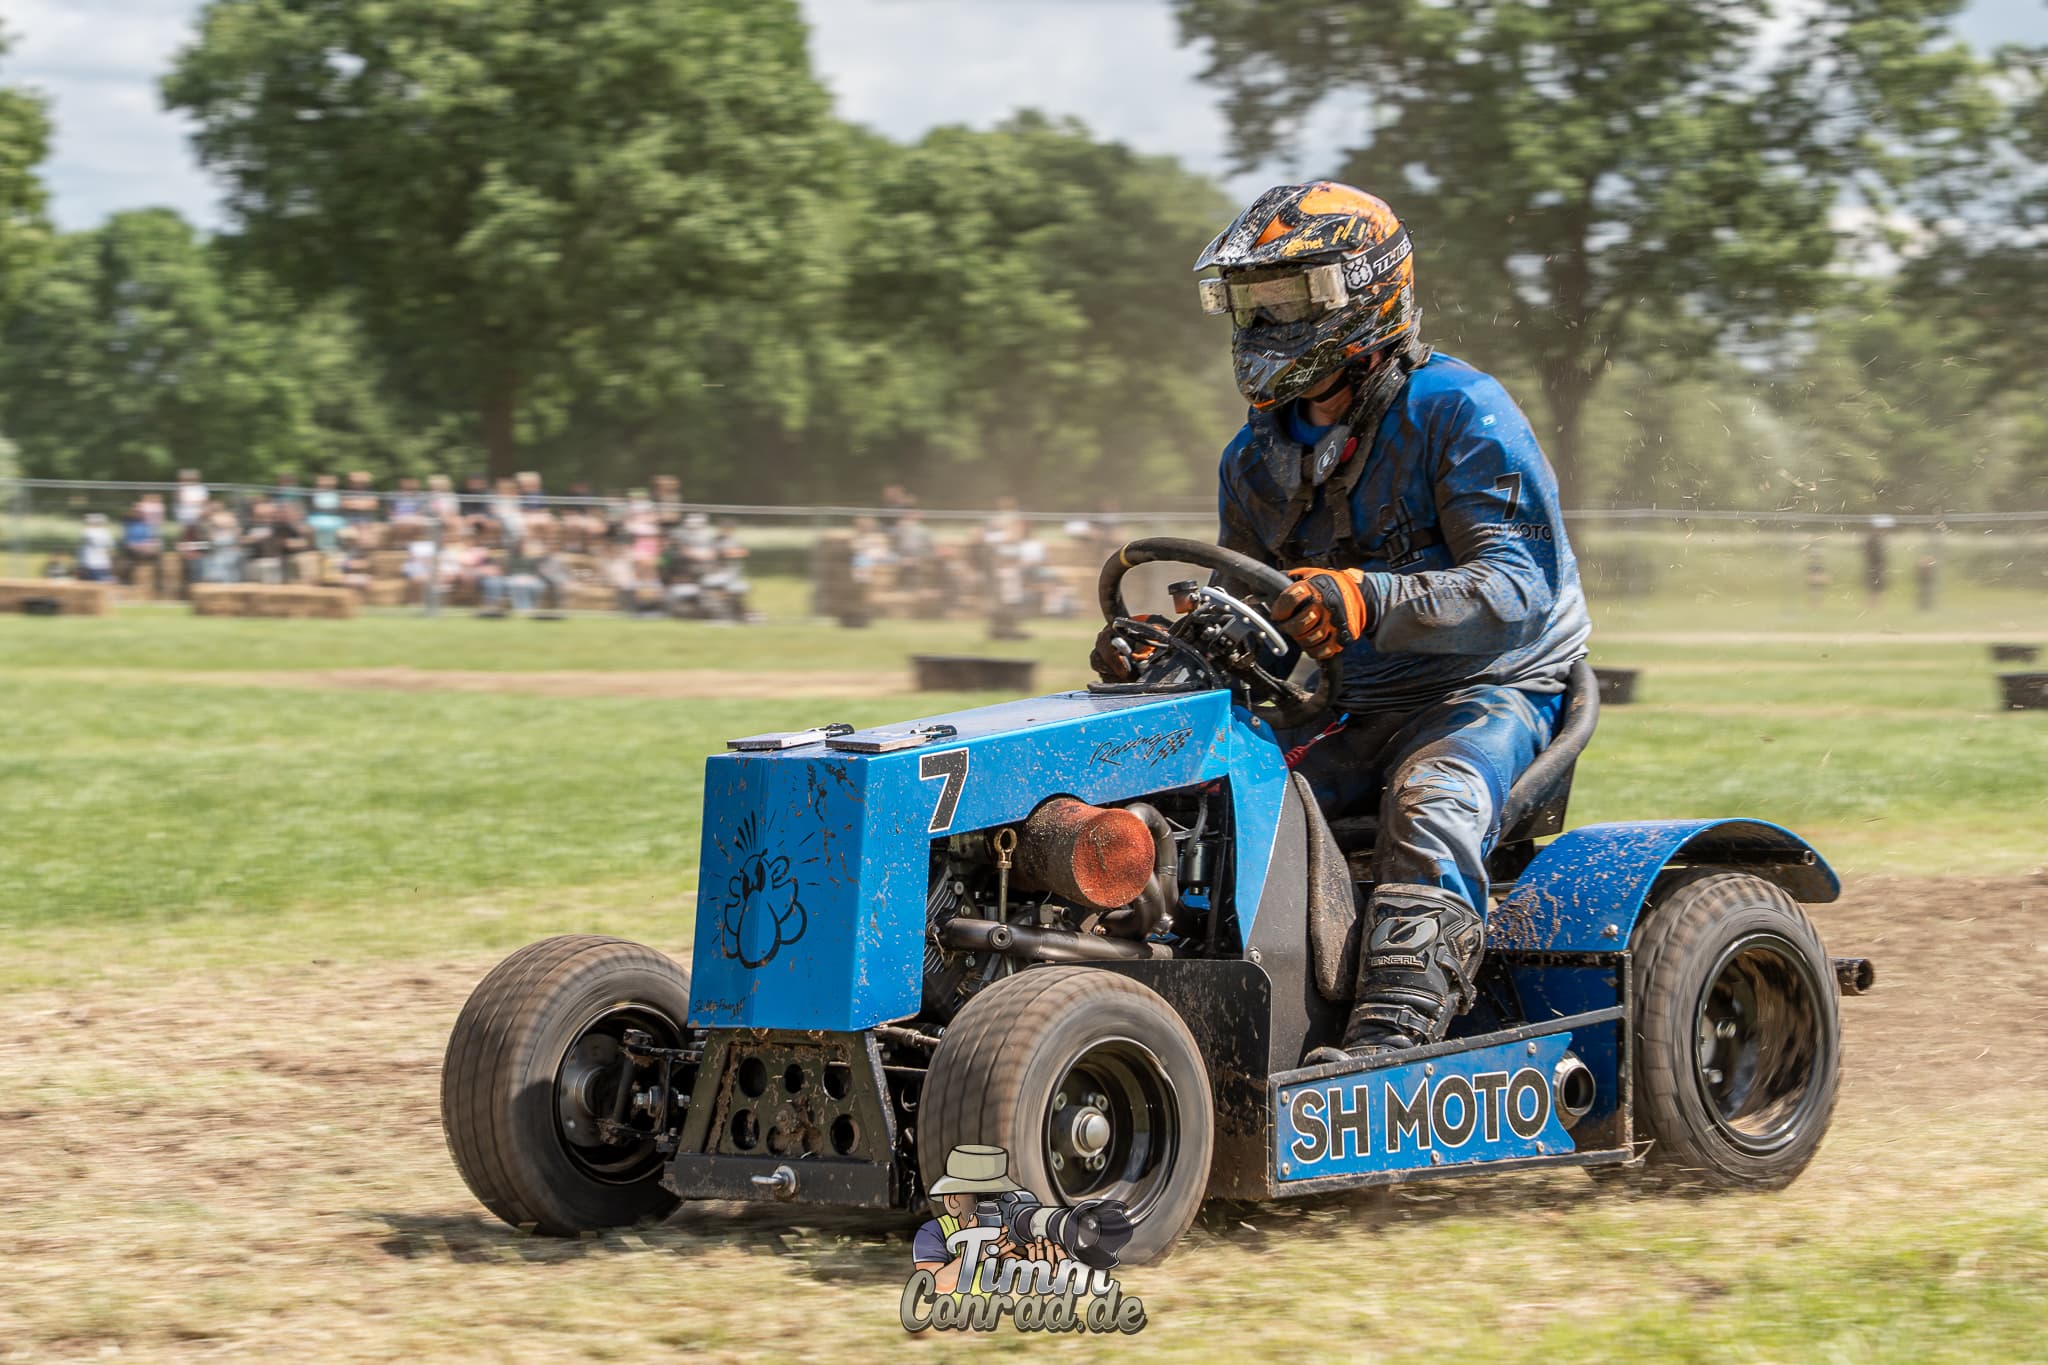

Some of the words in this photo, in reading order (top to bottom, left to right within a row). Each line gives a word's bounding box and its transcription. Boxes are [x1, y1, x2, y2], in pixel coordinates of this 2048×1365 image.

[1495, 472, 1521, 521] 7
[1089, 731, 1166, 767] Racing
[919, 747, 969, 833] 7
[1290, 1084, 1370, 1163] SH
[1384, 1067, 1551, 1154] MOTO
